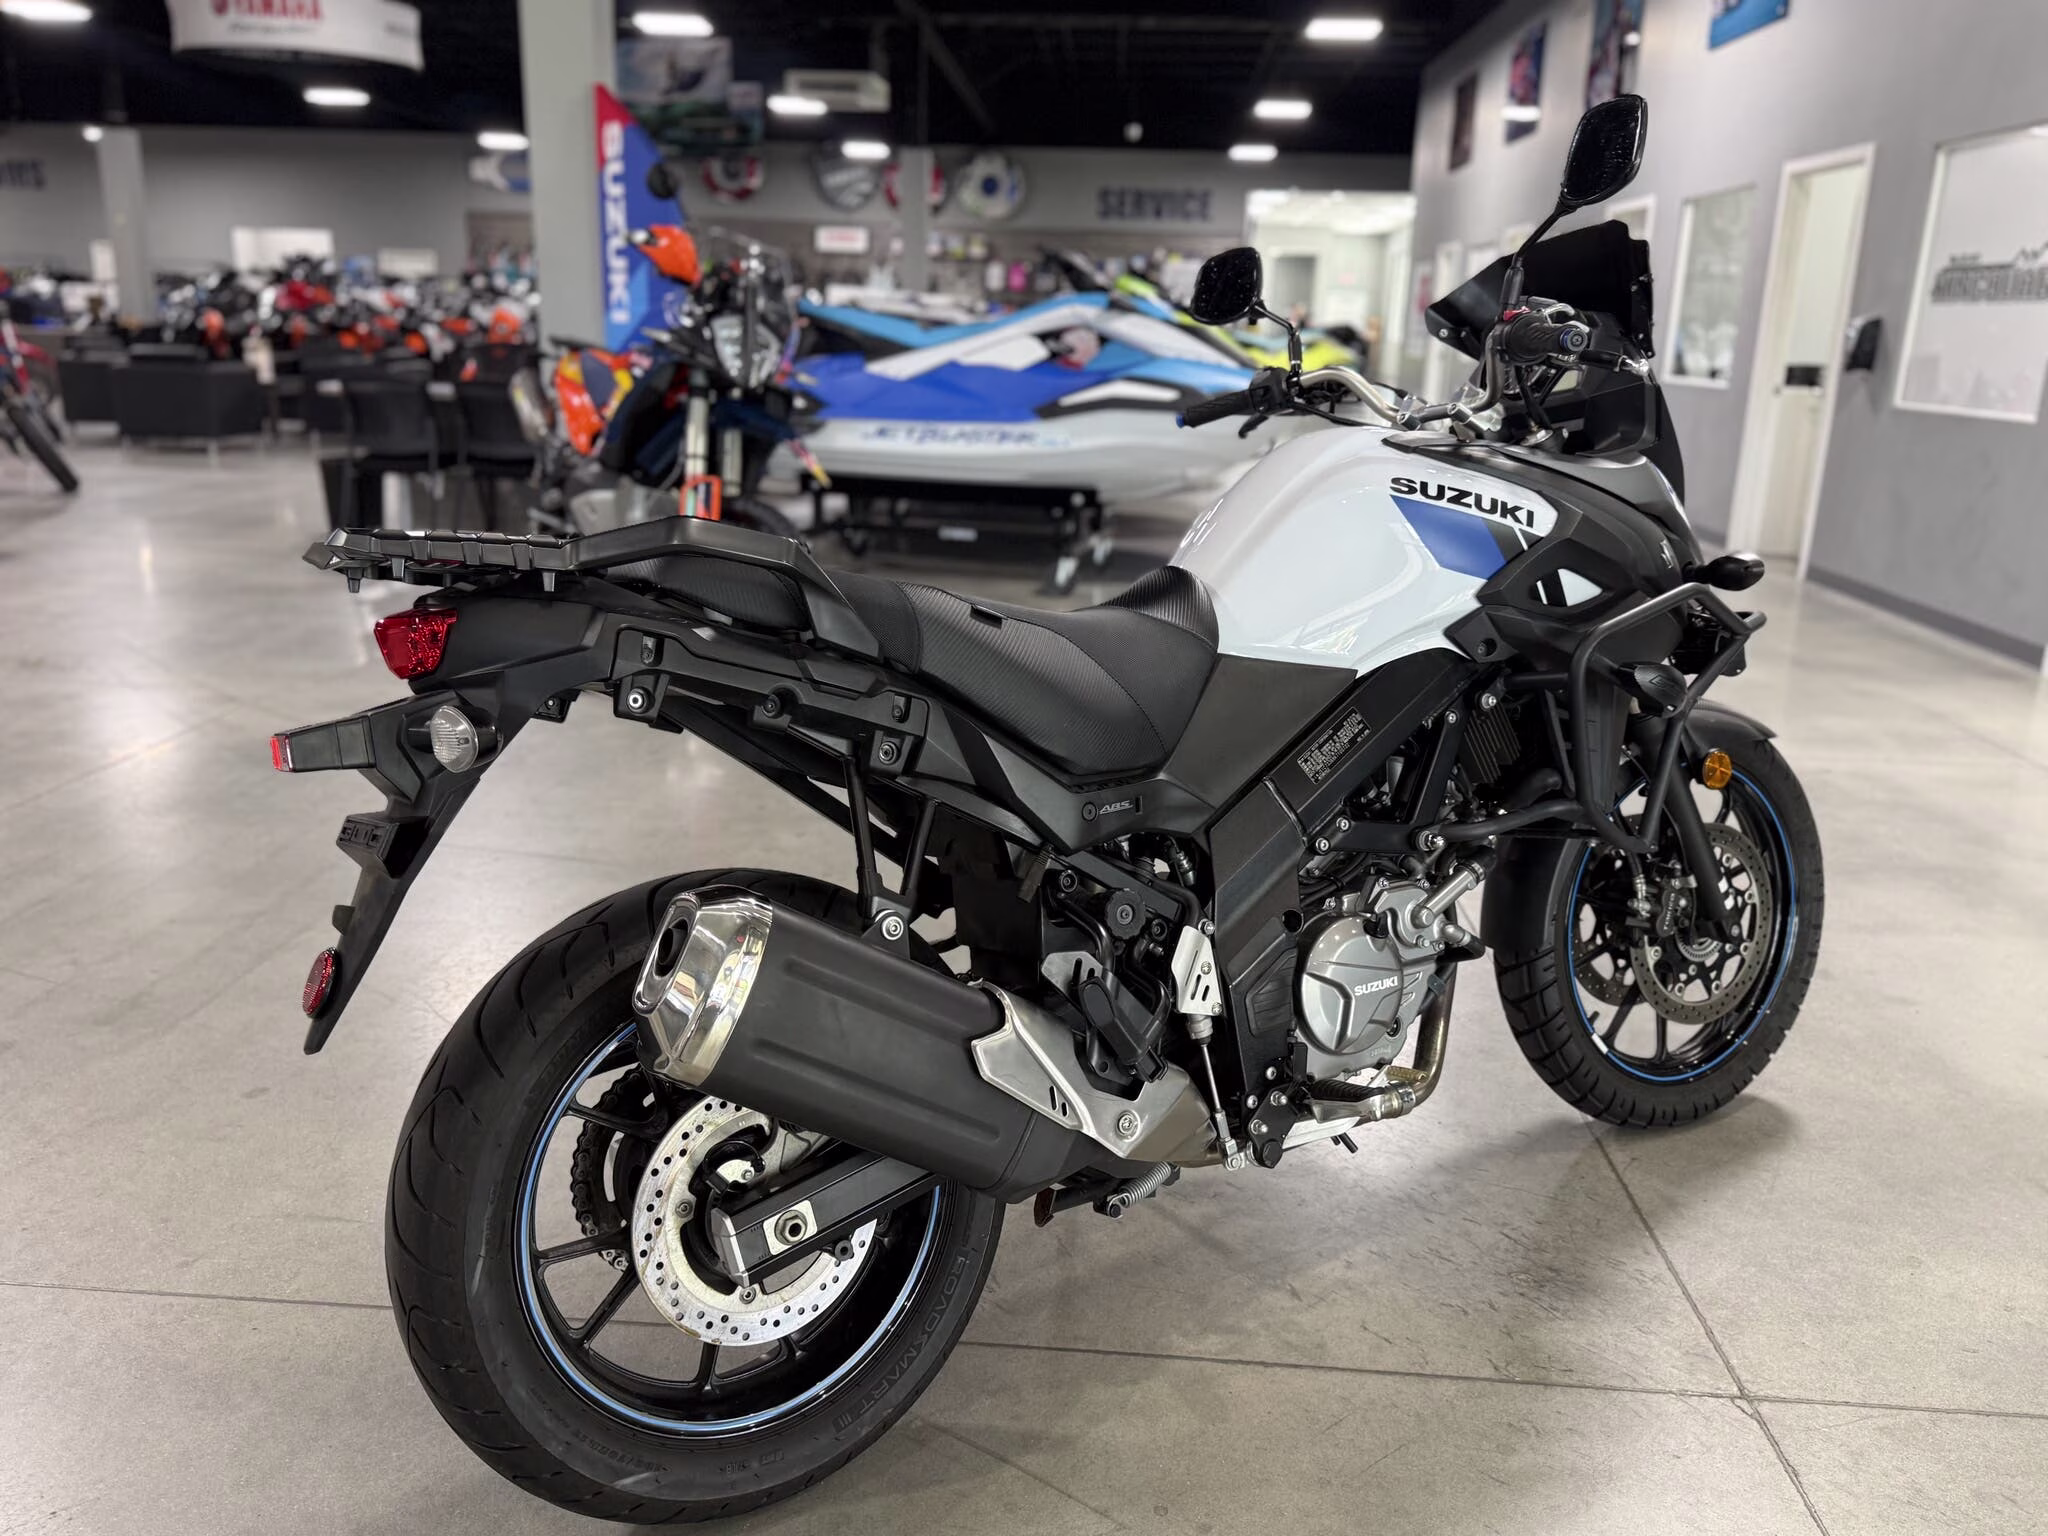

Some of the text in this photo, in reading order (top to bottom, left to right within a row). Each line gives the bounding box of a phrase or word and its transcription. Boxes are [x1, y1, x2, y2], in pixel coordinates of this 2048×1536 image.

[602, 119, 631, 325] SUZUKI
[1389, 476, 1535, 529] SUZUKI
[1099, 799, 1134, 815] ABS
[1354, 975, 1398, 996] SUZUKI
